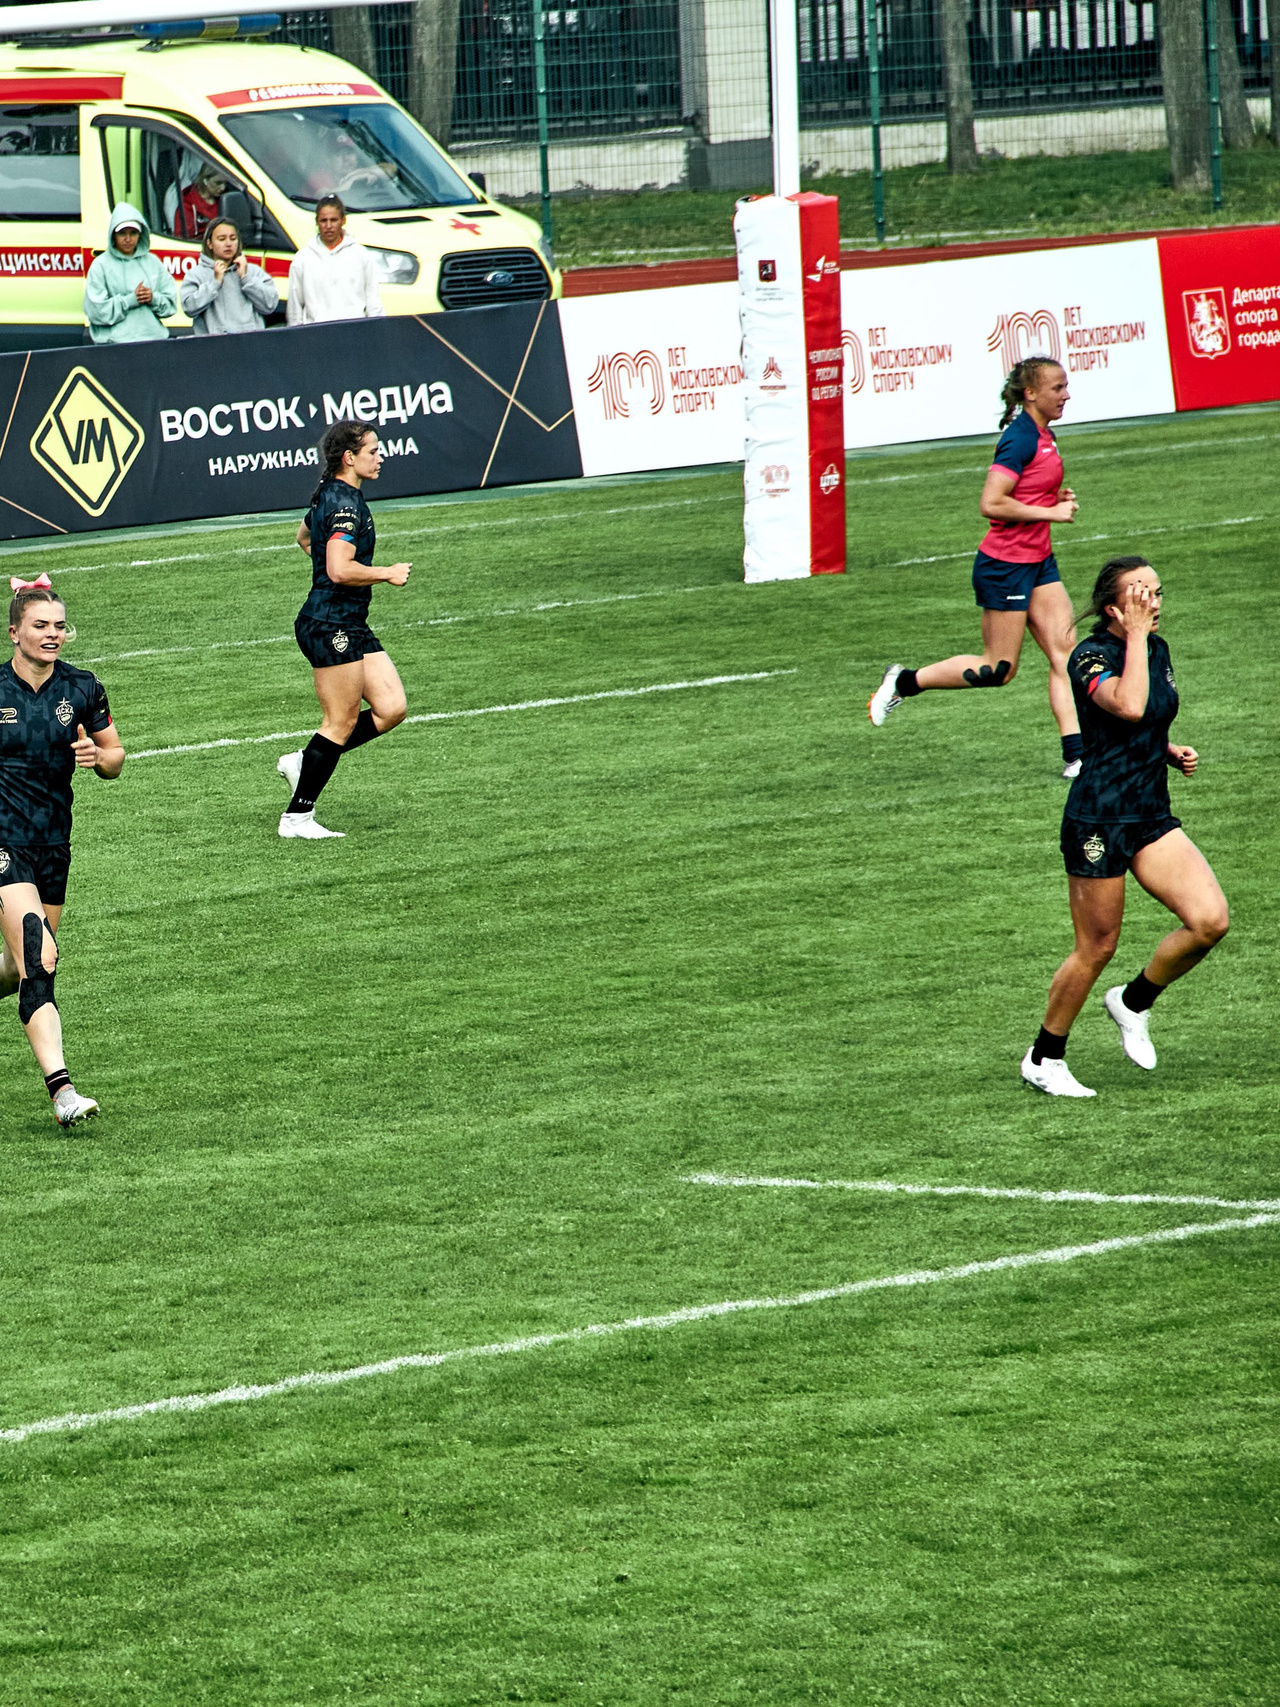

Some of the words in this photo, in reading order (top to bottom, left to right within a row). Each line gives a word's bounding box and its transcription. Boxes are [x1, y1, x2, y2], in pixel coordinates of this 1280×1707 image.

[1063, 306, 1082, 327] ЛЕТ
[1235, 307, 1278, 327] спорта
[868, 326, 886, 347] ЛЕТ
[1065, 321, 1145, 350] МОСКОВСКОМУ
[668, 347, 686, 367] ЛЕТ
[870, 344, 952, 370] МОСКОВСКОМУ
[1068, 349, 1109, 372] СПОРТУ
[670, 365, 745, 390] МОСКОВСКОМ
[873, 371, 914, 393] СПОРТУ
[673, 391, 715, 414] СПОРТУ
[160, 396, 305, 442] ВОСТОК
[208, 447, 319, 476] НАРУЖНАЯ
